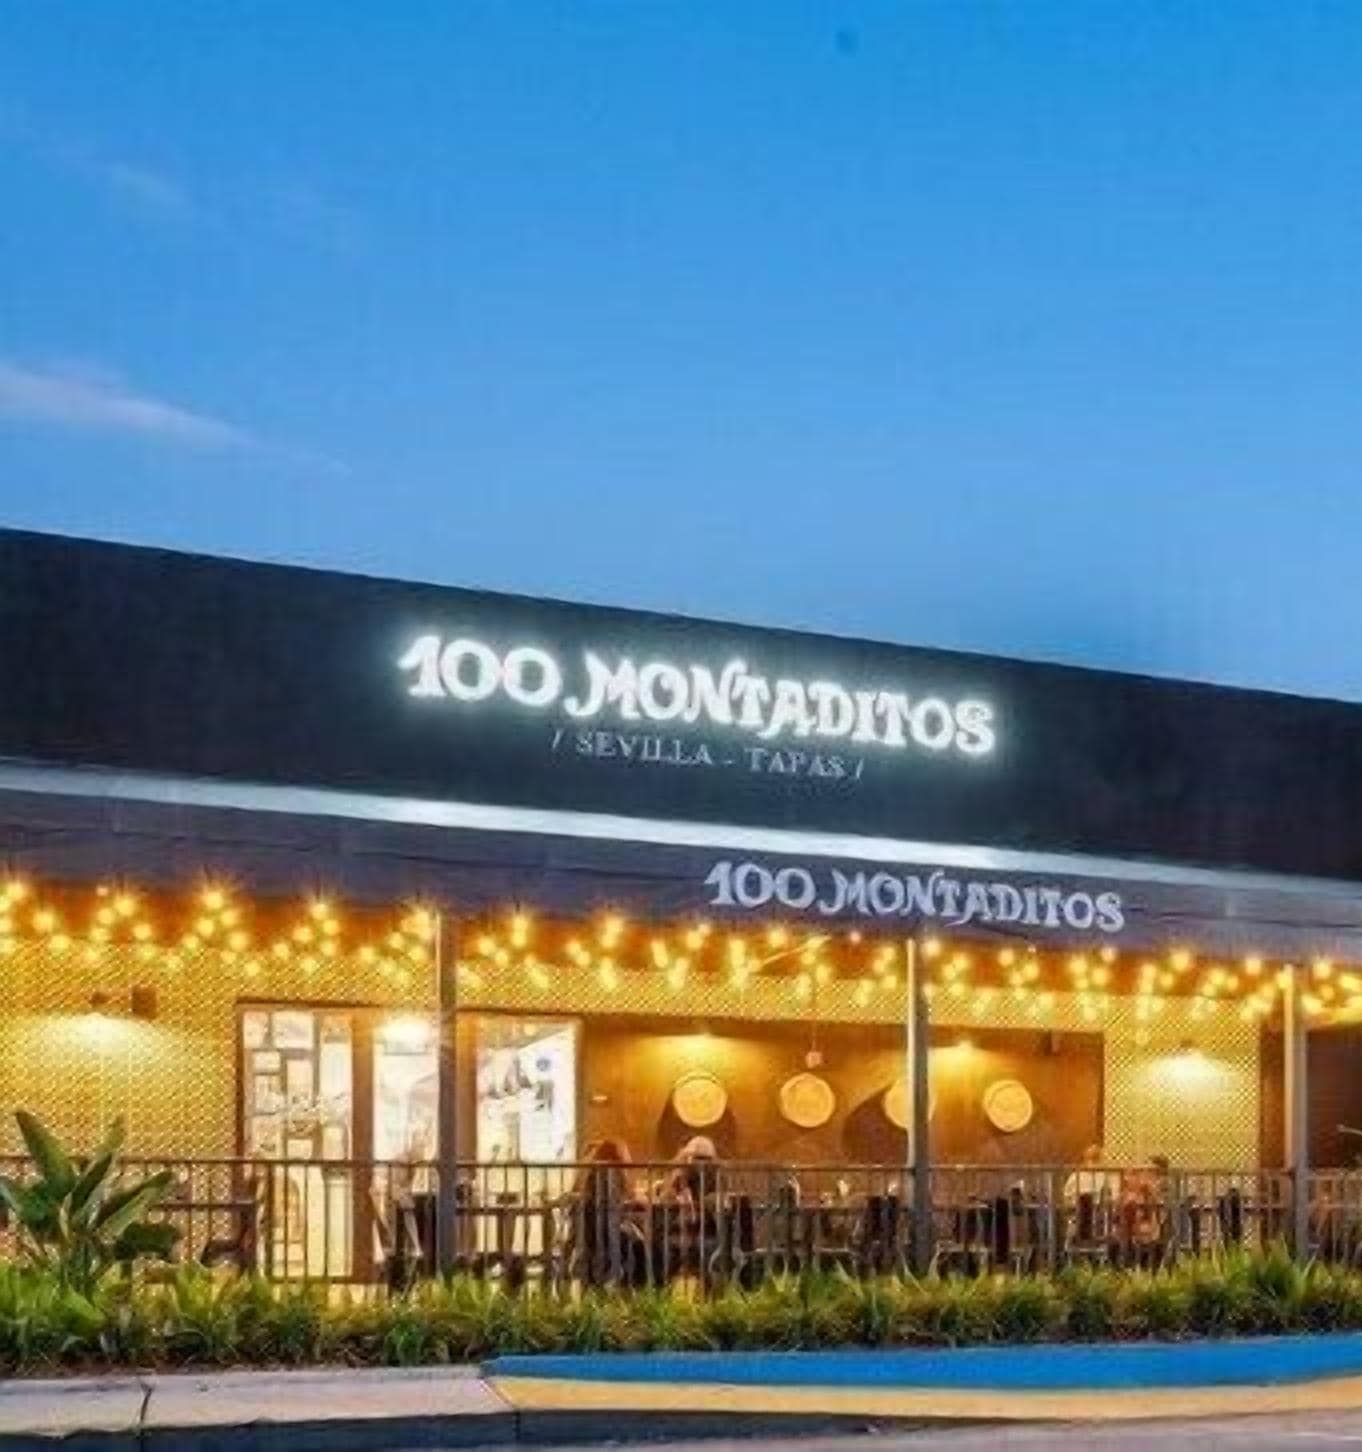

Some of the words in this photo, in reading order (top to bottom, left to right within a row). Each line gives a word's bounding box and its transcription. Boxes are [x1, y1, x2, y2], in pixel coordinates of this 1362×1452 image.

[398, 633, 560, 708] 100
[564, 649, 997, 754] MONTADITOS
[575, 732, 713, 765] SEVILLA
[704, 861, 817, 909] 100
[819, 868, 1126, 933] MONTADITOS
